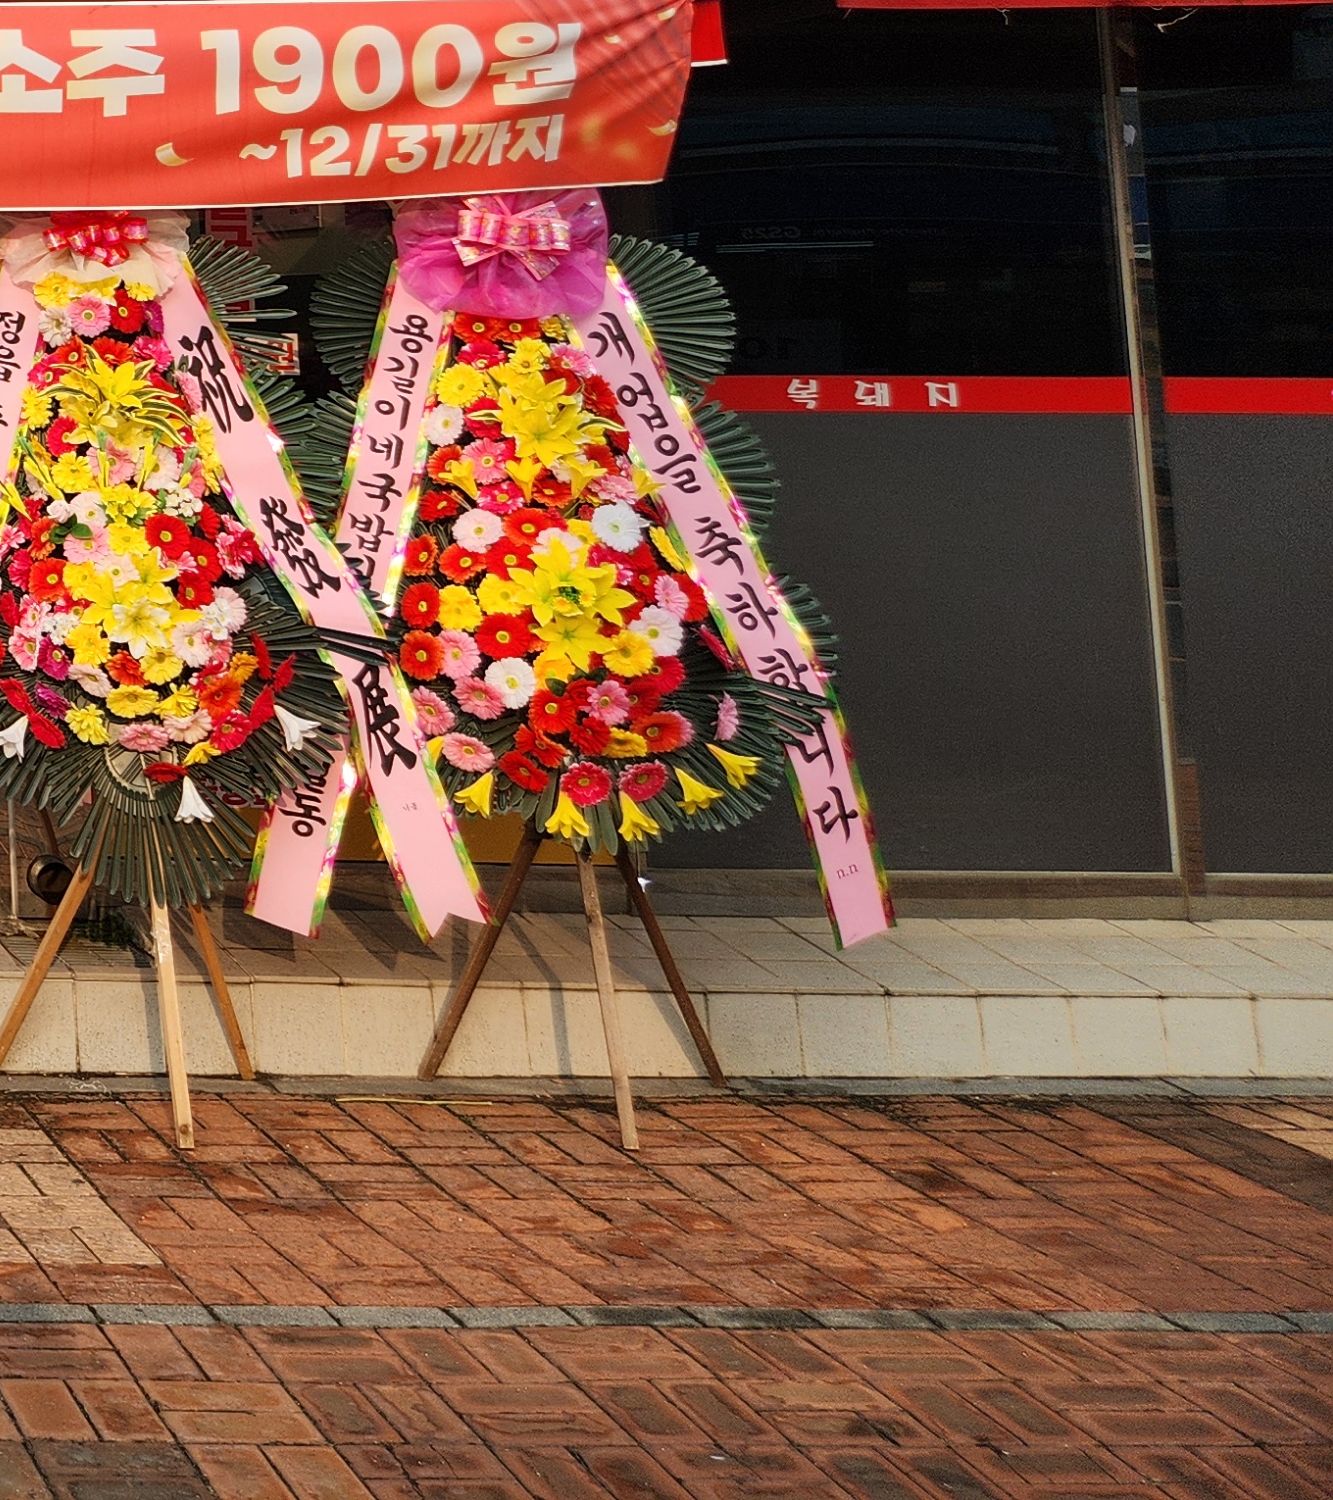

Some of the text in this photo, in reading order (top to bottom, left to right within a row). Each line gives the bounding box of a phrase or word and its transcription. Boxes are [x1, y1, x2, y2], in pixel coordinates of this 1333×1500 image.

[199, 20, 582, 117] 1900원
[238, 113, 563, 180] ~12/31까지
[587, 311, 702, 494] 개업을
